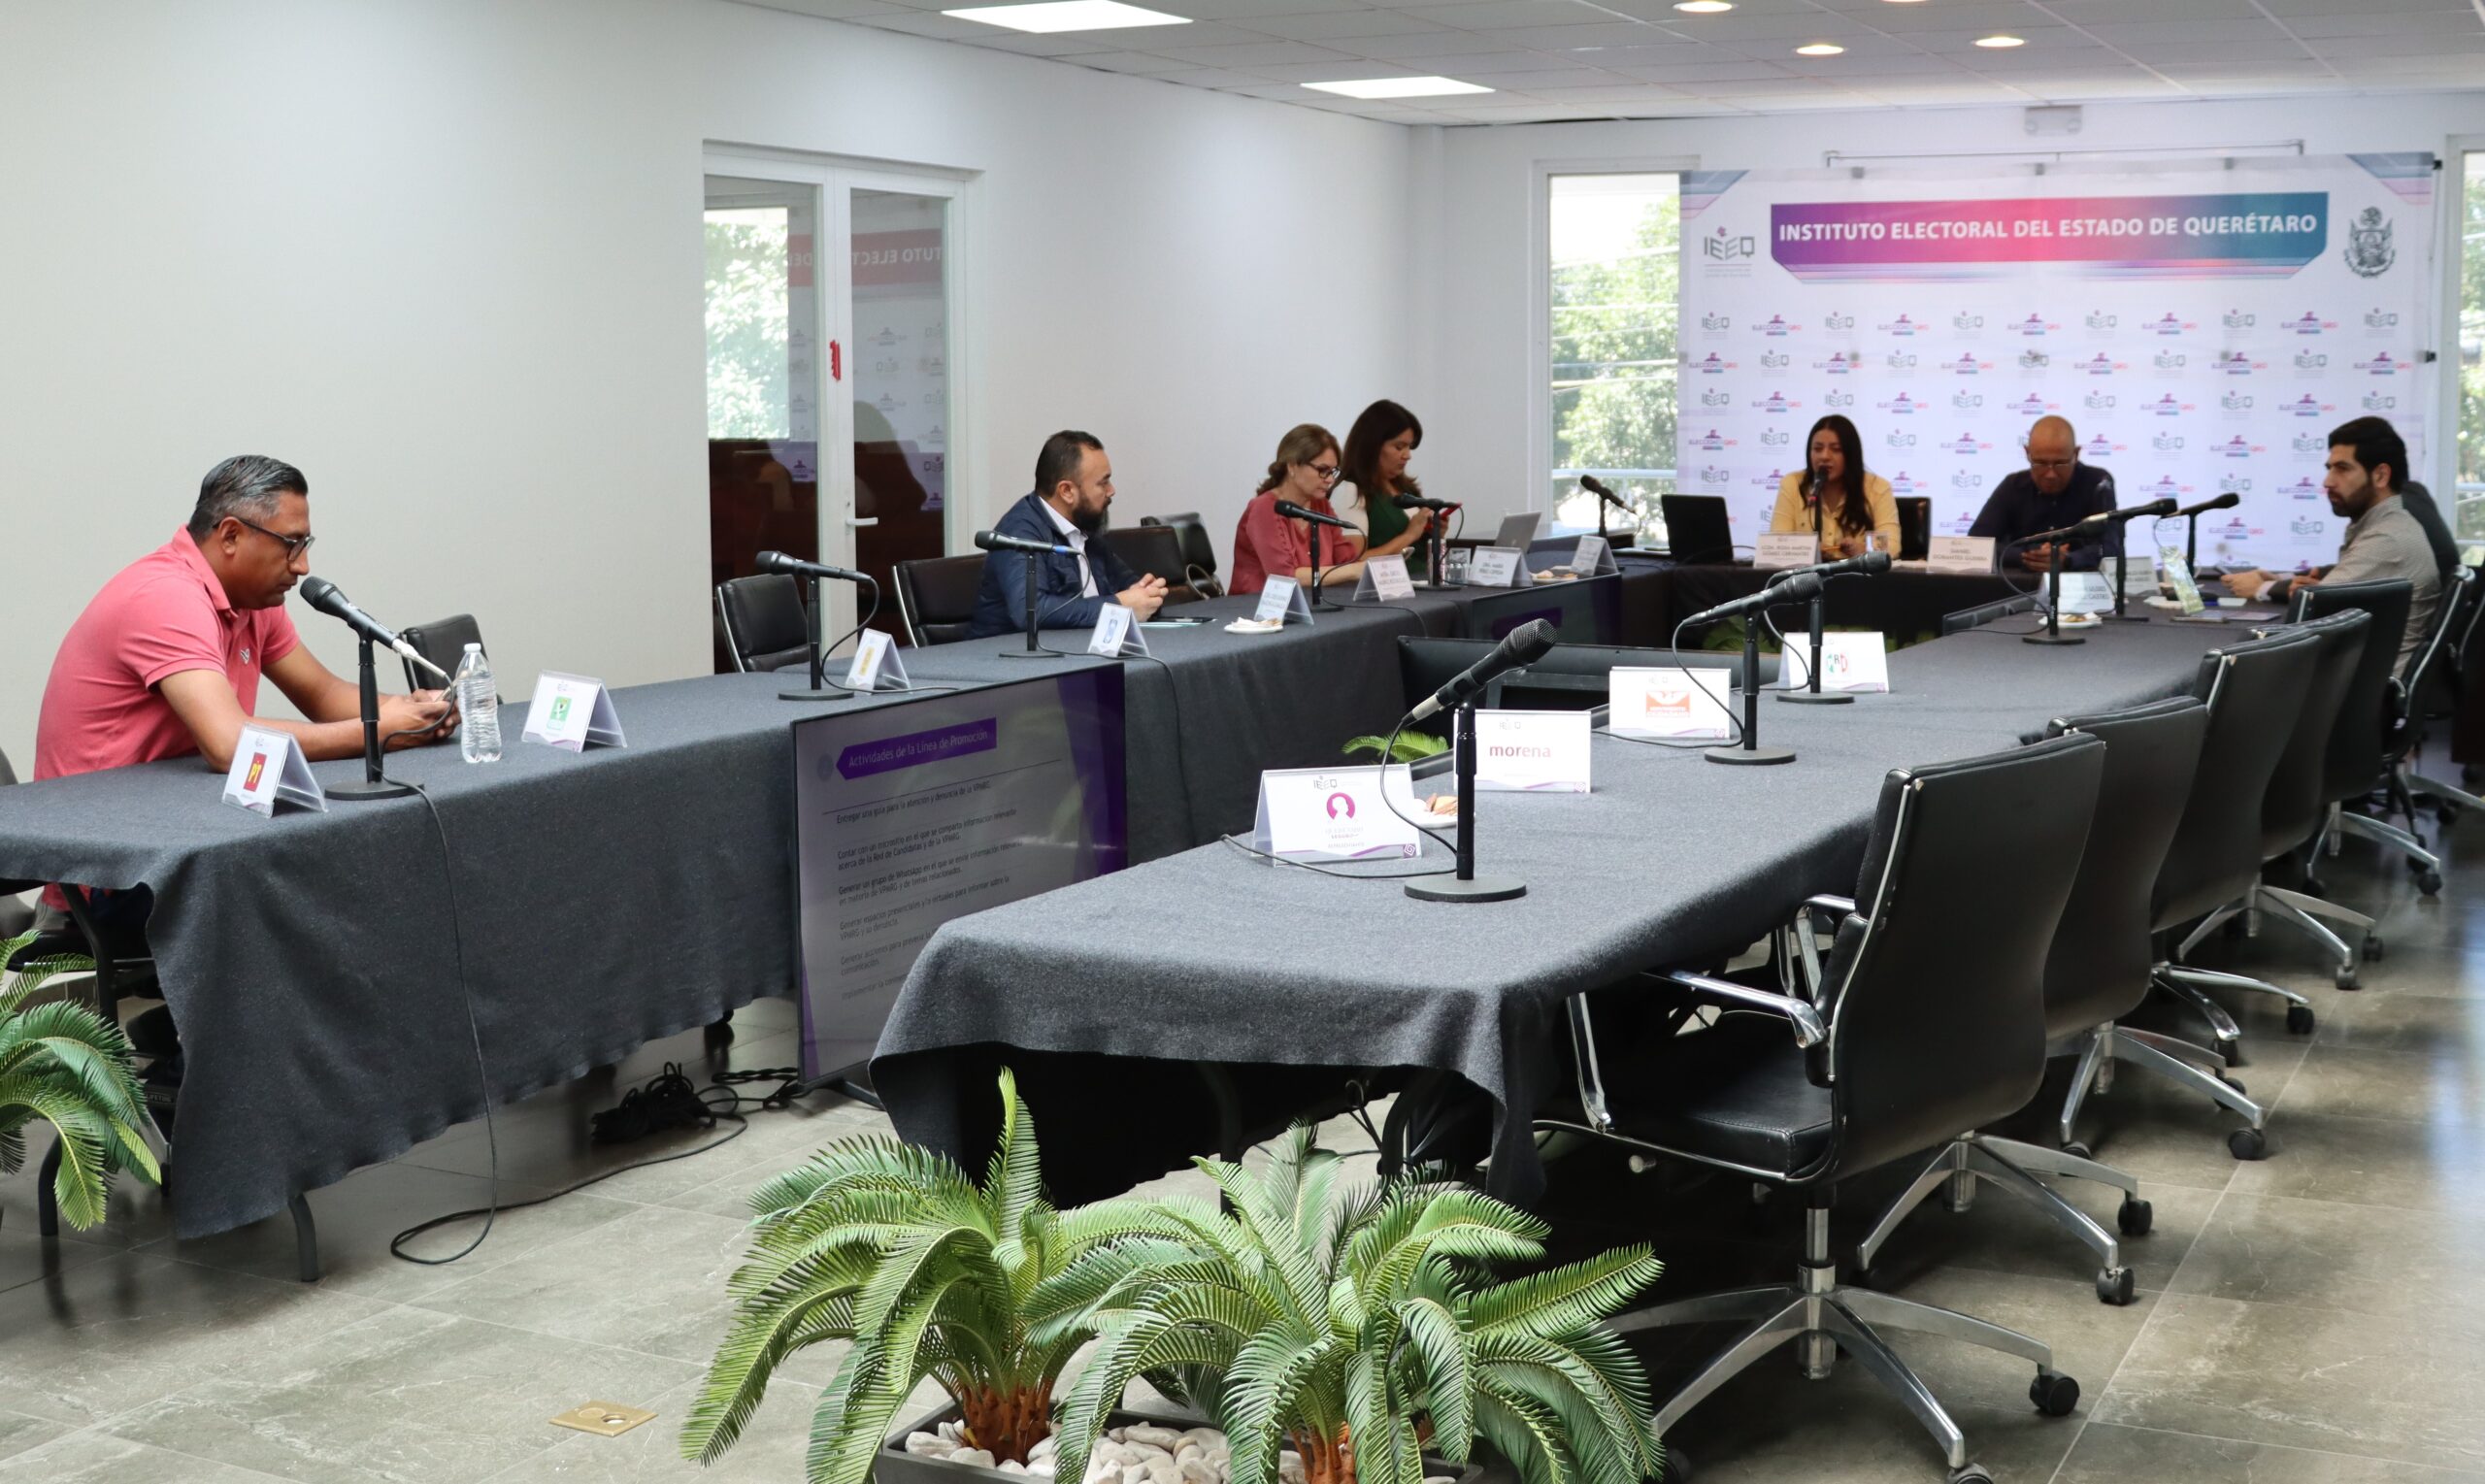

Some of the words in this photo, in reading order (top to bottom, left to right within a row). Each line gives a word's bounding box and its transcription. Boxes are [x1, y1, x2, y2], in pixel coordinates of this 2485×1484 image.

[1778, 222, 1885, 242] INSTITUTO
[1890, 220, 2007, 241] ELECTORAL
[2013, 219, 2053, 238] DEL
[2059, 217, 2142, 237] ESTADO
[2148, 216, 2178, 235] DE
[2184, 213, 2318, 237] QUERÉTARO
[1703, 235, 1755, 261] IEEQ
[848, 746, 893, 768] Actividades
[949, 728, 987, 747] Promoción
[1489, 744, 1551, 758] morena
[837, 809, 860, 826] Entregar
